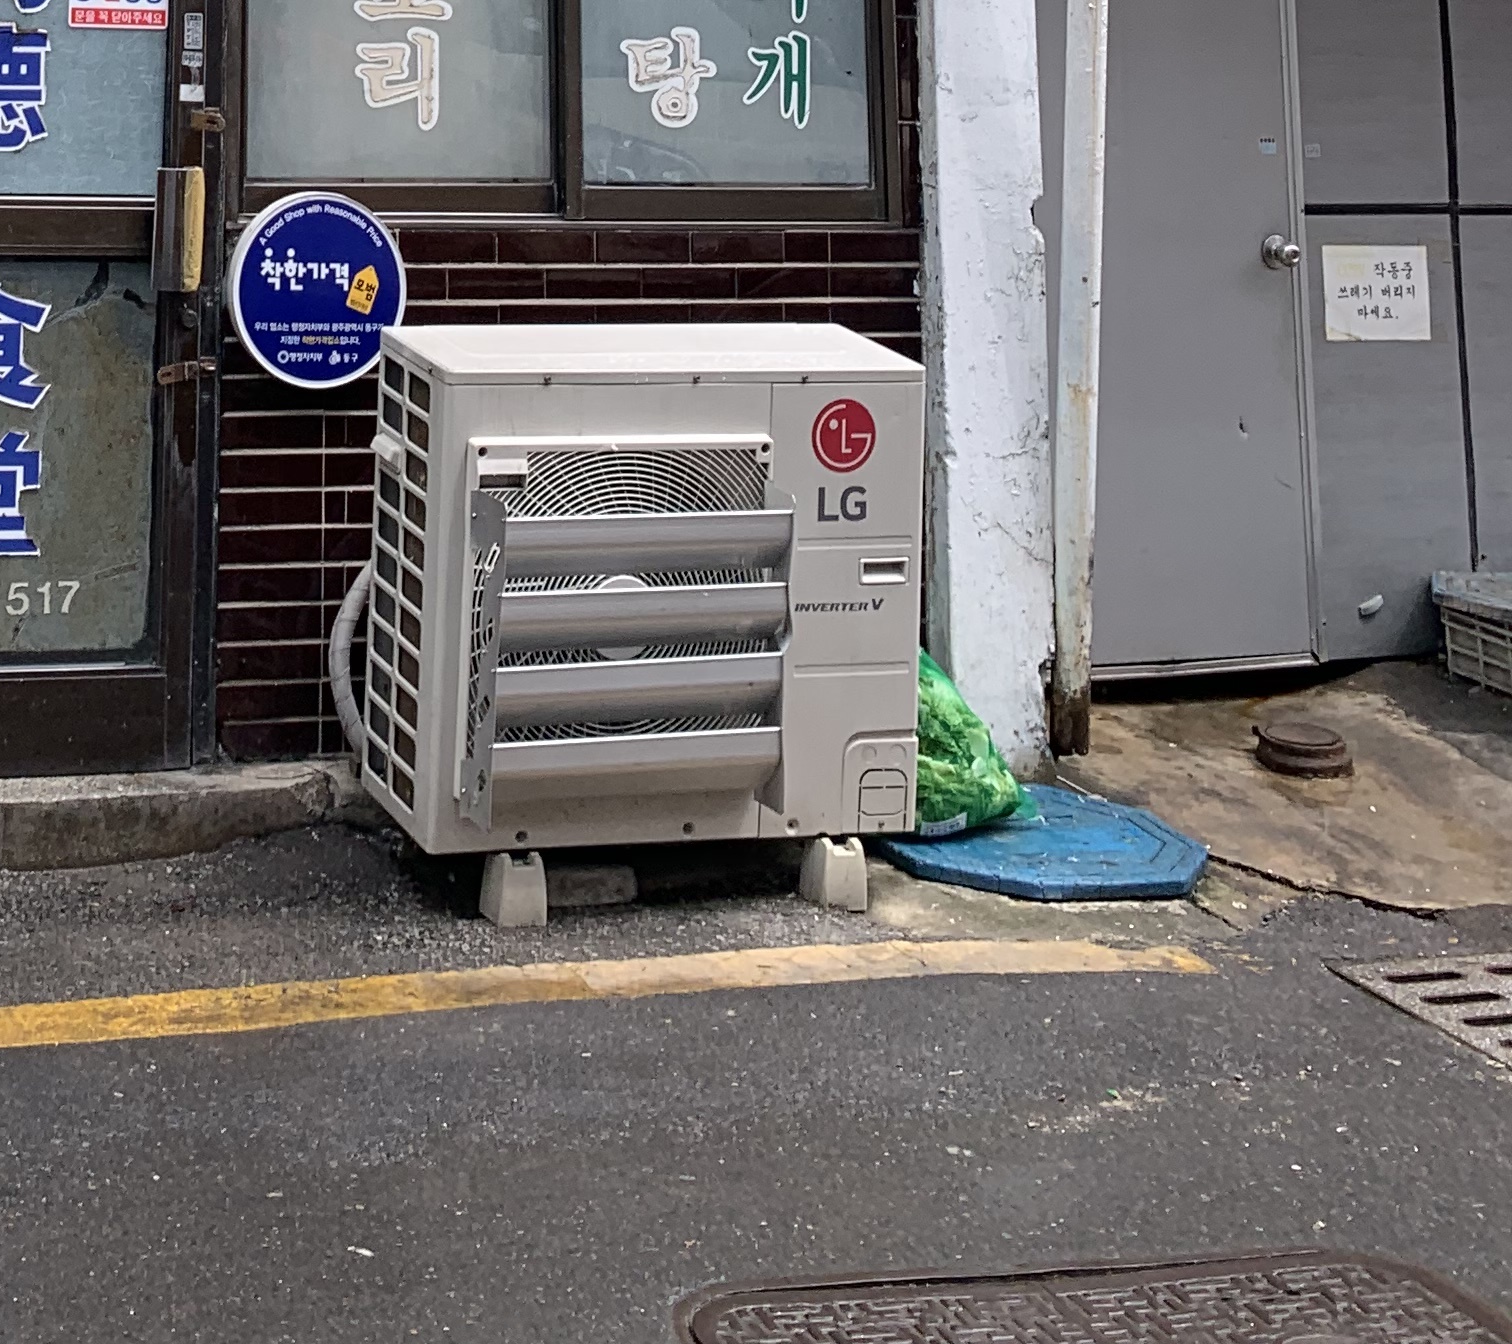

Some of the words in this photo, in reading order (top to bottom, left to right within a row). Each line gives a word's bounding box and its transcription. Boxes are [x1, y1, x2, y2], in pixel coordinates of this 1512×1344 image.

[264, 216, 285, 238] Good
[283, 208, 306, 223] Shop
[306, 203, 323, 214] with
[324, 203, 369, 230] Reasonable
[366, 225, 384, 248] Price
[260, 248, 350, 292] 착한가격
[818, 486, 867, 521] LG
[795, 601, 869, 613] INVERTER
